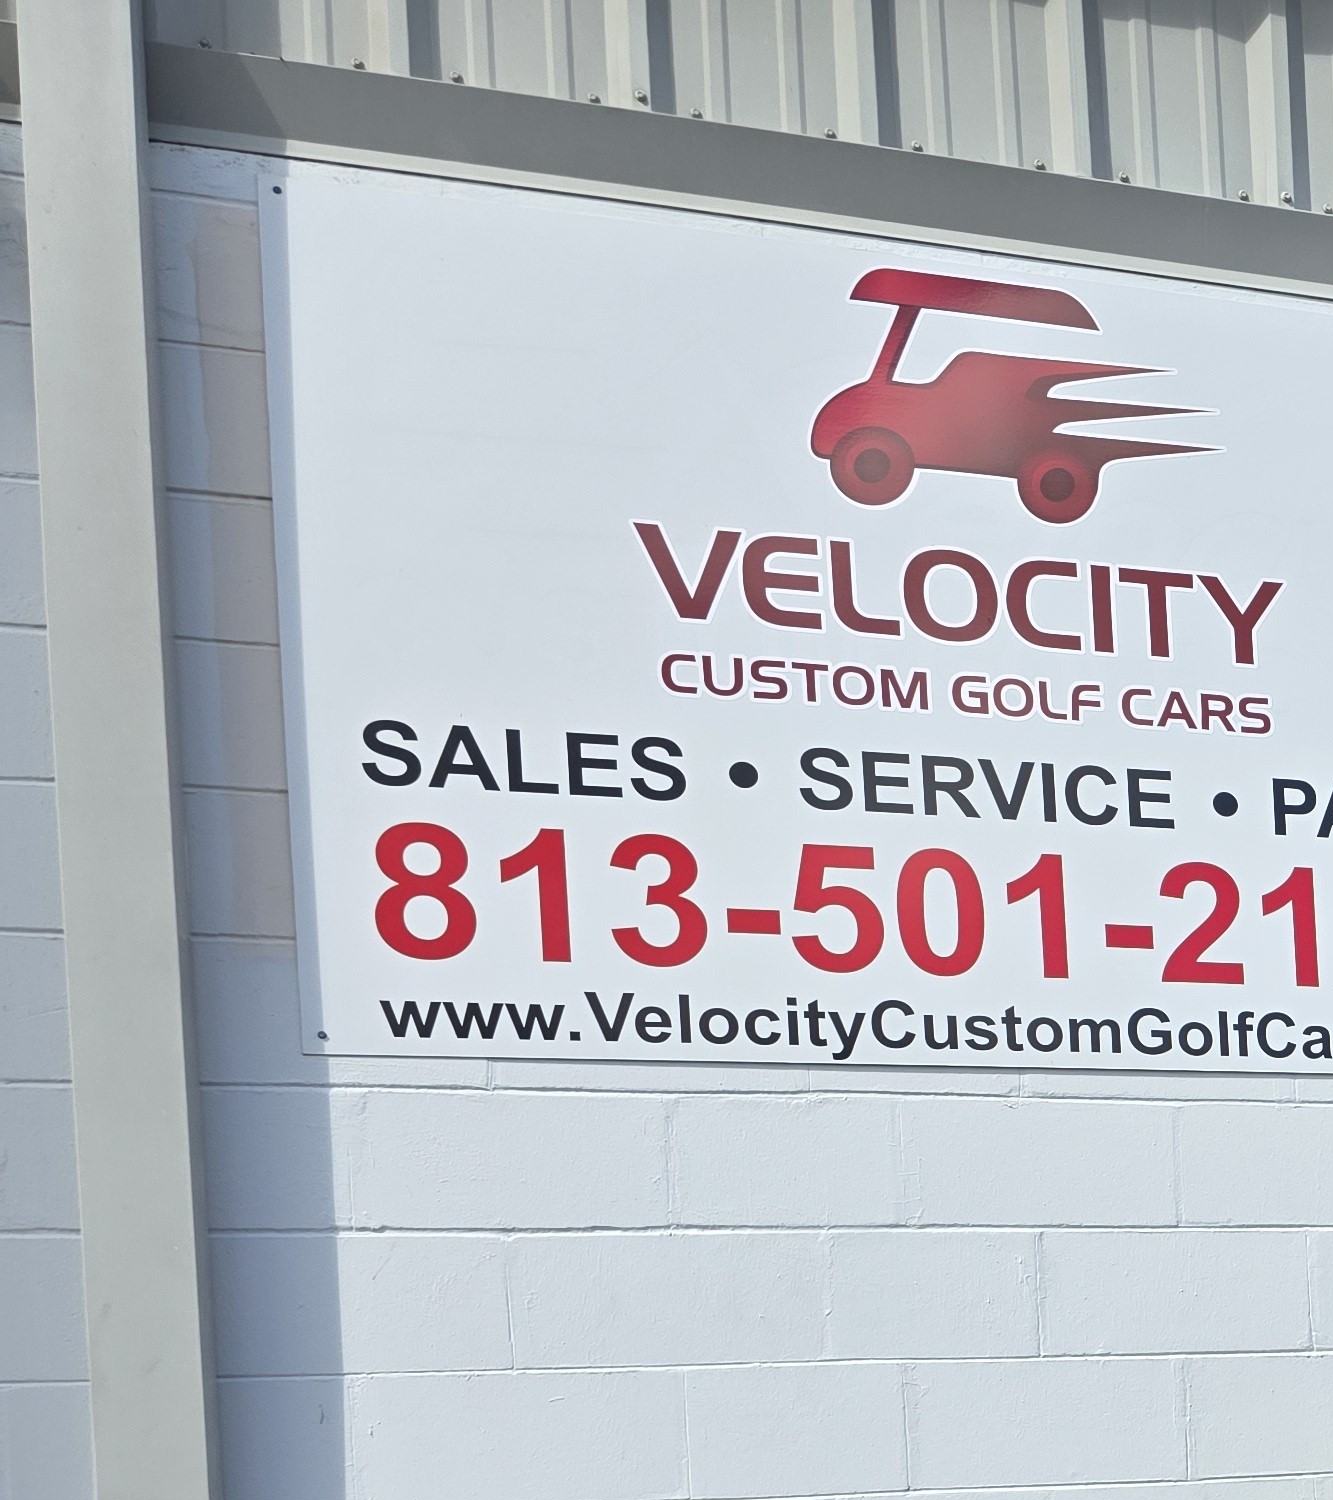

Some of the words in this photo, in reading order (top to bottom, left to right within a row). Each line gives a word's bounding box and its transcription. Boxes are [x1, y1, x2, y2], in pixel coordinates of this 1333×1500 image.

[633, 523, 1283, 665] VELOCITY
[662, 654, 929, 710] CUSTOM
[952, 676, 1101, 721] GOLF
[1122, 689, 1271, 735] CARS
[362, 720, 687, 801] SALES
[800, 748, 1175, 829] SERVICE
